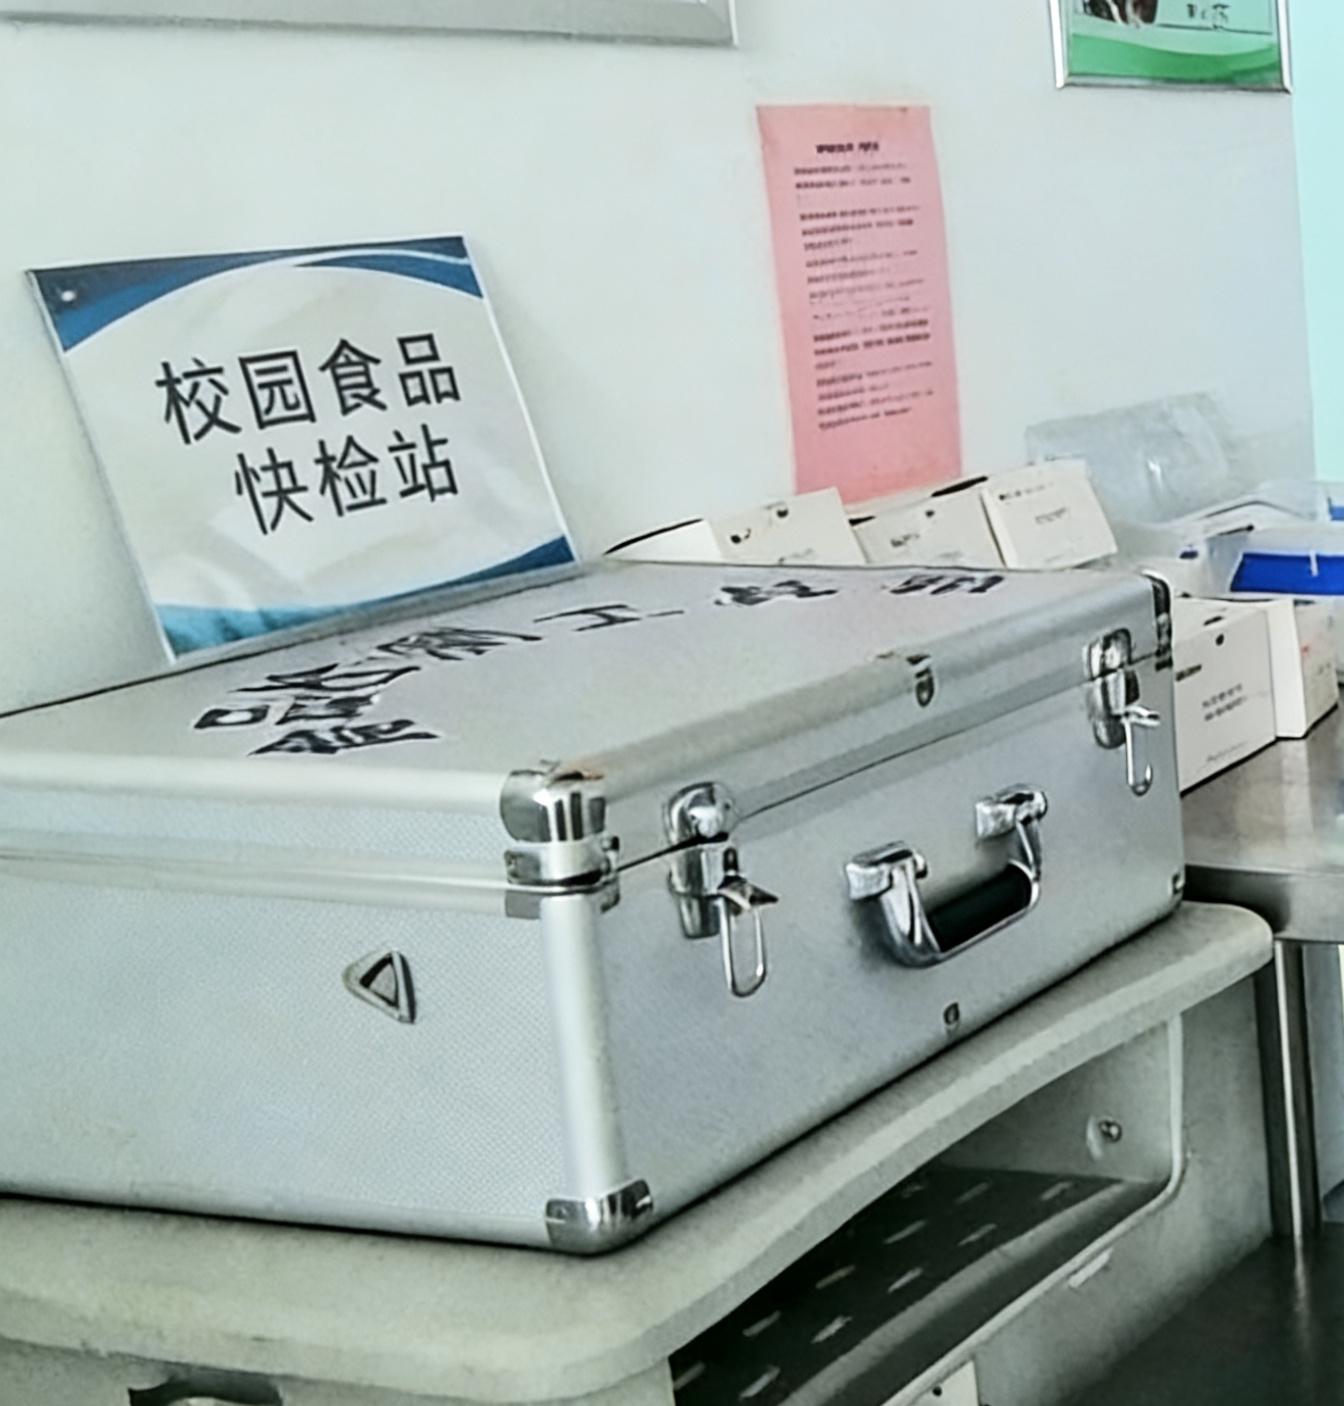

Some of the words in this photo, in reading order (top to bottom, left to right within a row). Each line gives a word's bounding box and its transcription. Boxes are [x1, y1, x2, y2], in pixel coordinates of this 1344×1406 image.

[155, 333, 461, 445] 校园食品
[233, 423, 458, 536] 快检站
